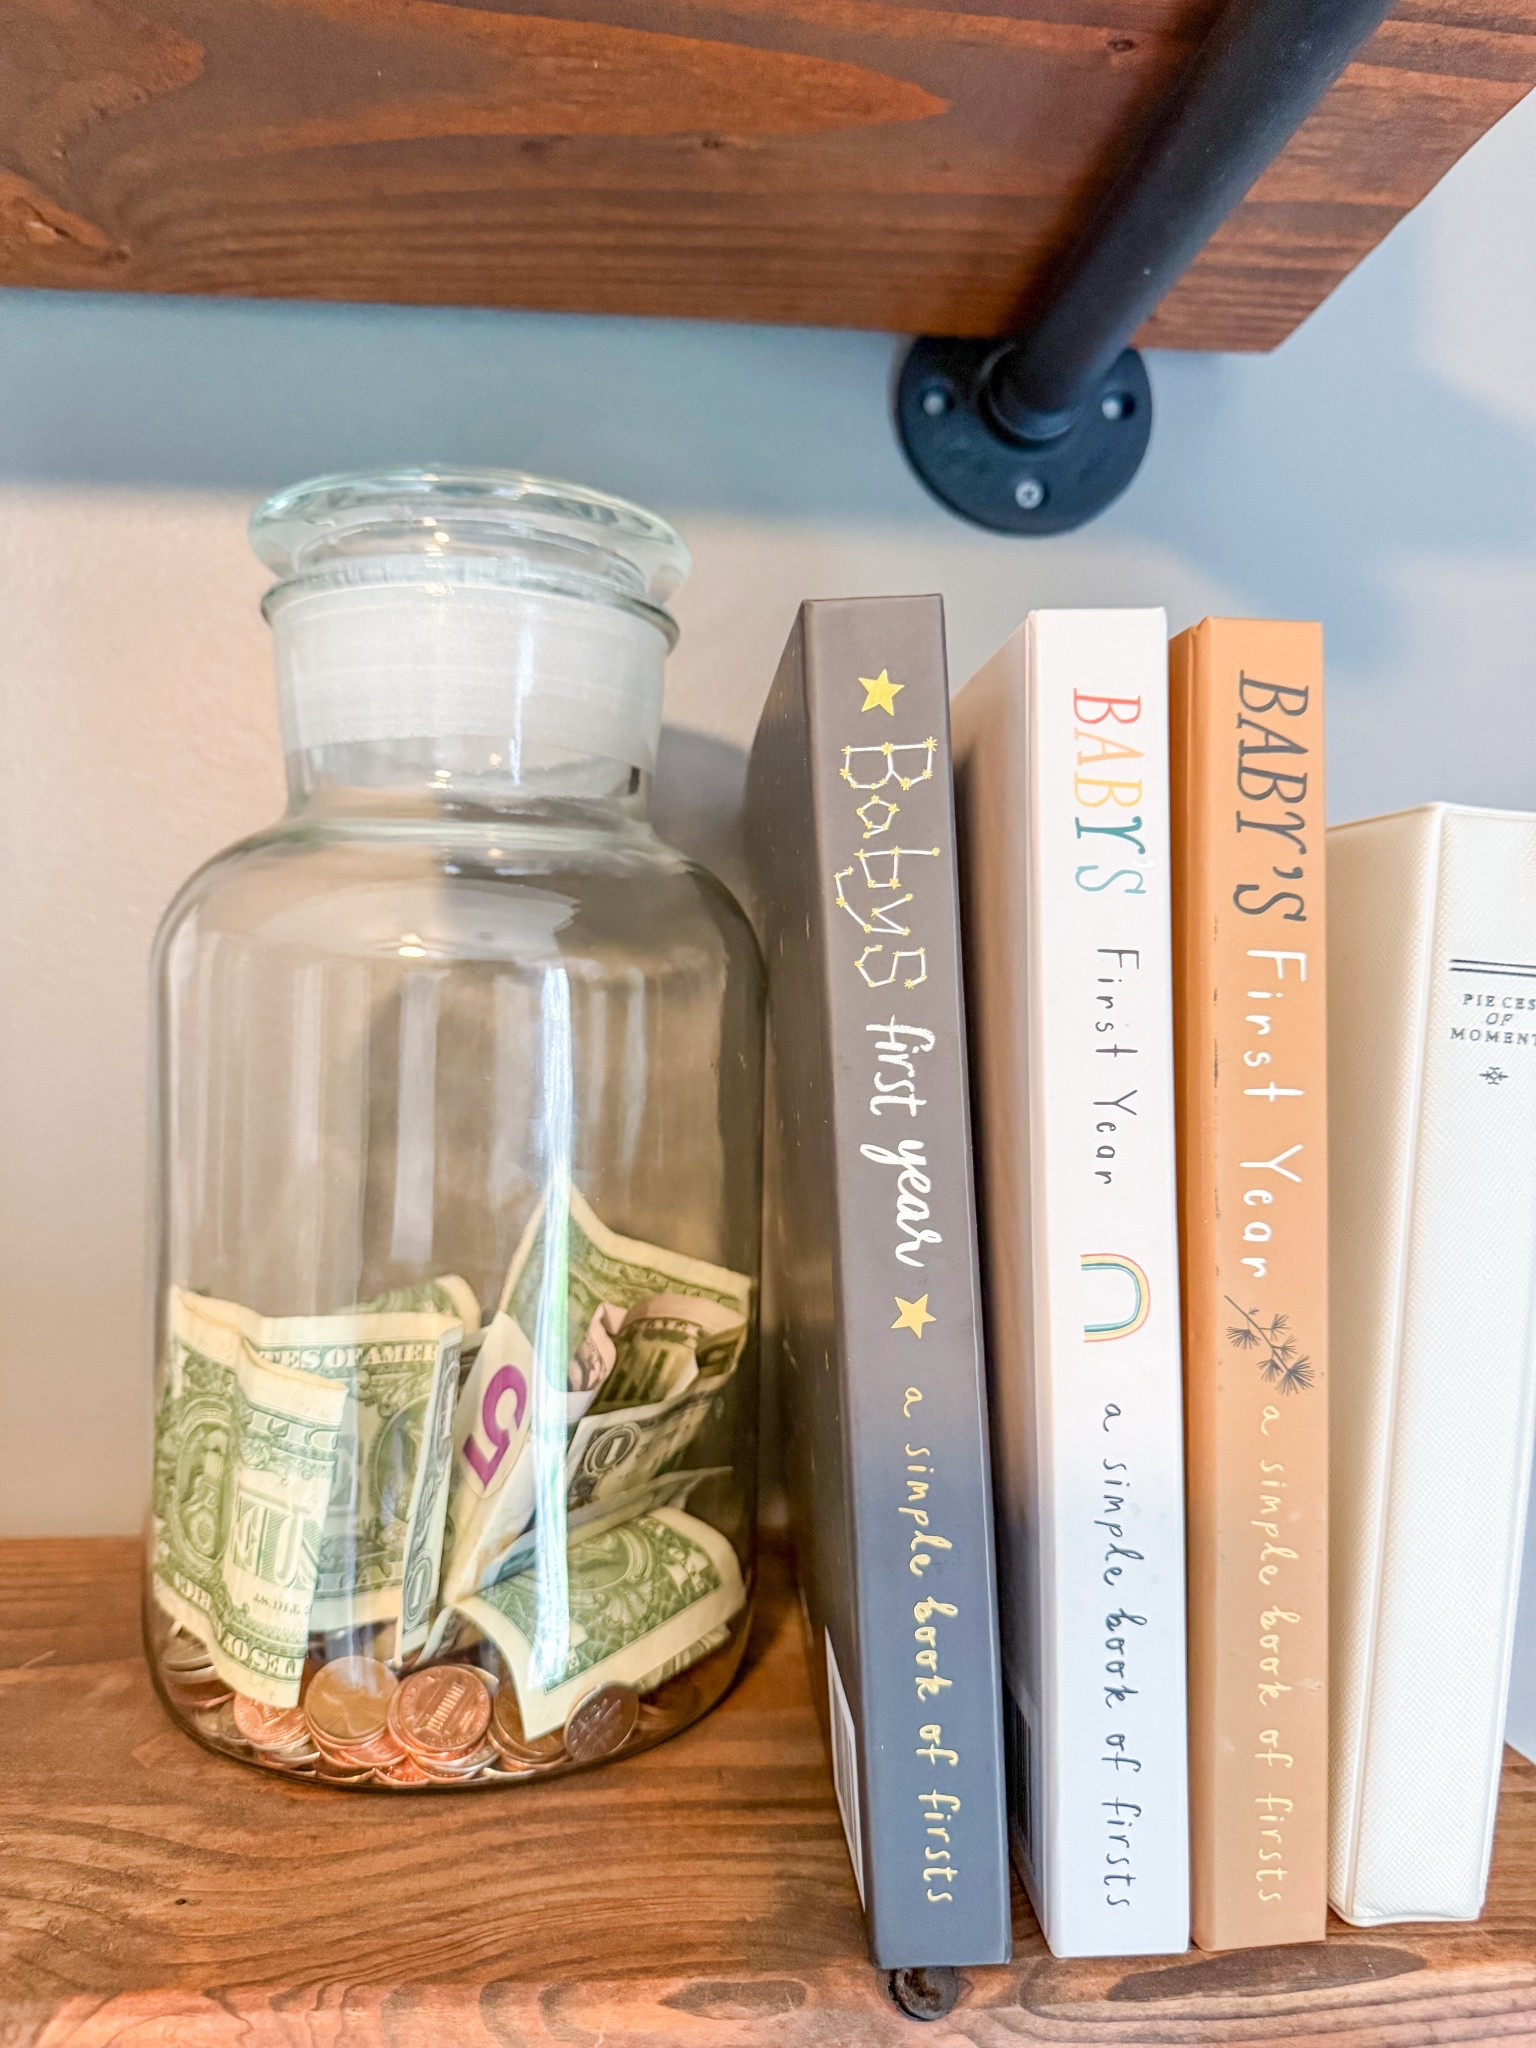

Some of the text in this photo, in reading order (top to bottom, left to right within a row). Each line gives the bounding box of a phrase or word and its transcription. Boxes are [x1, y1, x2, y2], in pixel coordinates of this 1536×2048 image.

[835, 736, 943, 1269] Babys first year
[1094, 948, 1139, 1058] First
[1231, 669, 1311, 1280] BABY'S First Year
[1462, 993, 1536, 1011] PIECES
[1485, 1012, 1513, 1026] OF
[1092, 1089, 1138, 1186] Year
[462, 1364, 528, 1490] 5
[898, 1385, 962, 1904] a simple book of firsts
[1093, 1402, 1148, 1908] a simple book of firsts
[1250, 1405, 1302, 1903] a simple book of firsts
